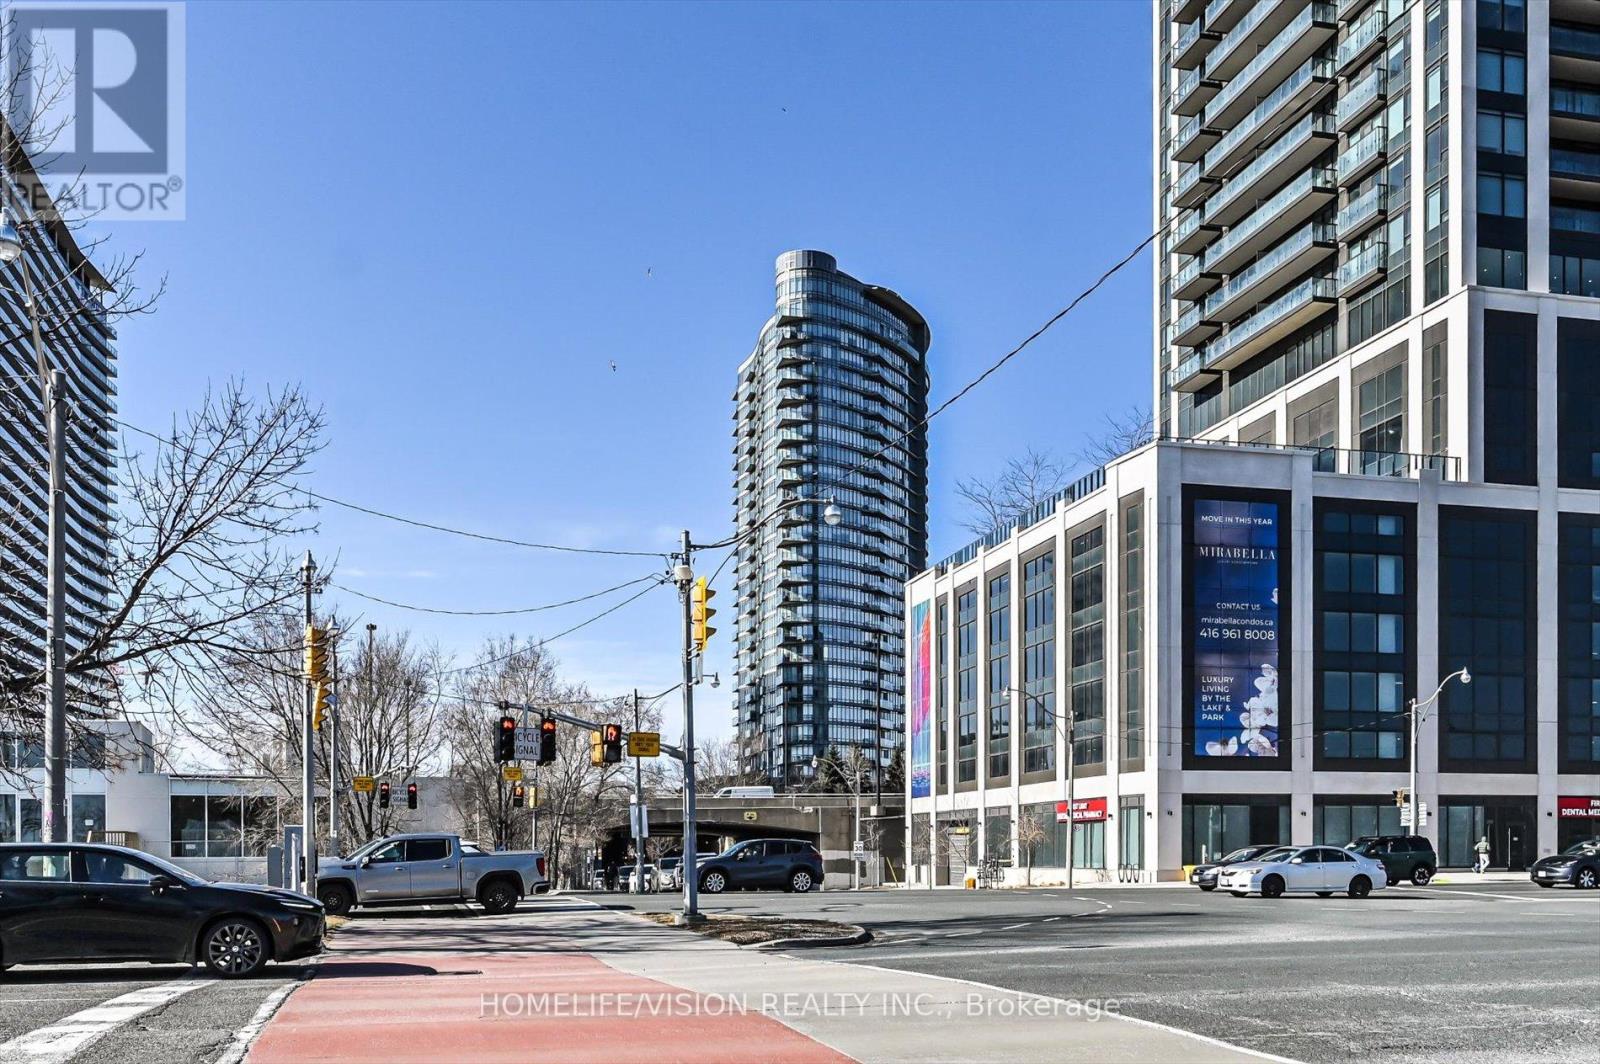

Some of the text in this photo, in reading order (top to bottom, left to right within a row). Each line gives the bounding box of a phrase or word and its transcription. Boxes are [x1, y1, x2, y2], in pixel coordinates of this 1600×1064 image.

[1201, 515, 1224, 523] MOVE
[1235, 516, 1252, 524] THIS
[1200, 546, 1276, 559] MIRABELLA
[1216, 602, 1261, 611] CONTACT US
[1202, 617, 1274, 626] mirabellacondos.ca
[1200, 628, 1275, 640] 416 961 8008
[1202, 685, 1230, 693] LIVING
[1225, 704, 1231, 712] &
[1202, 713, 1225, 721] PARK
